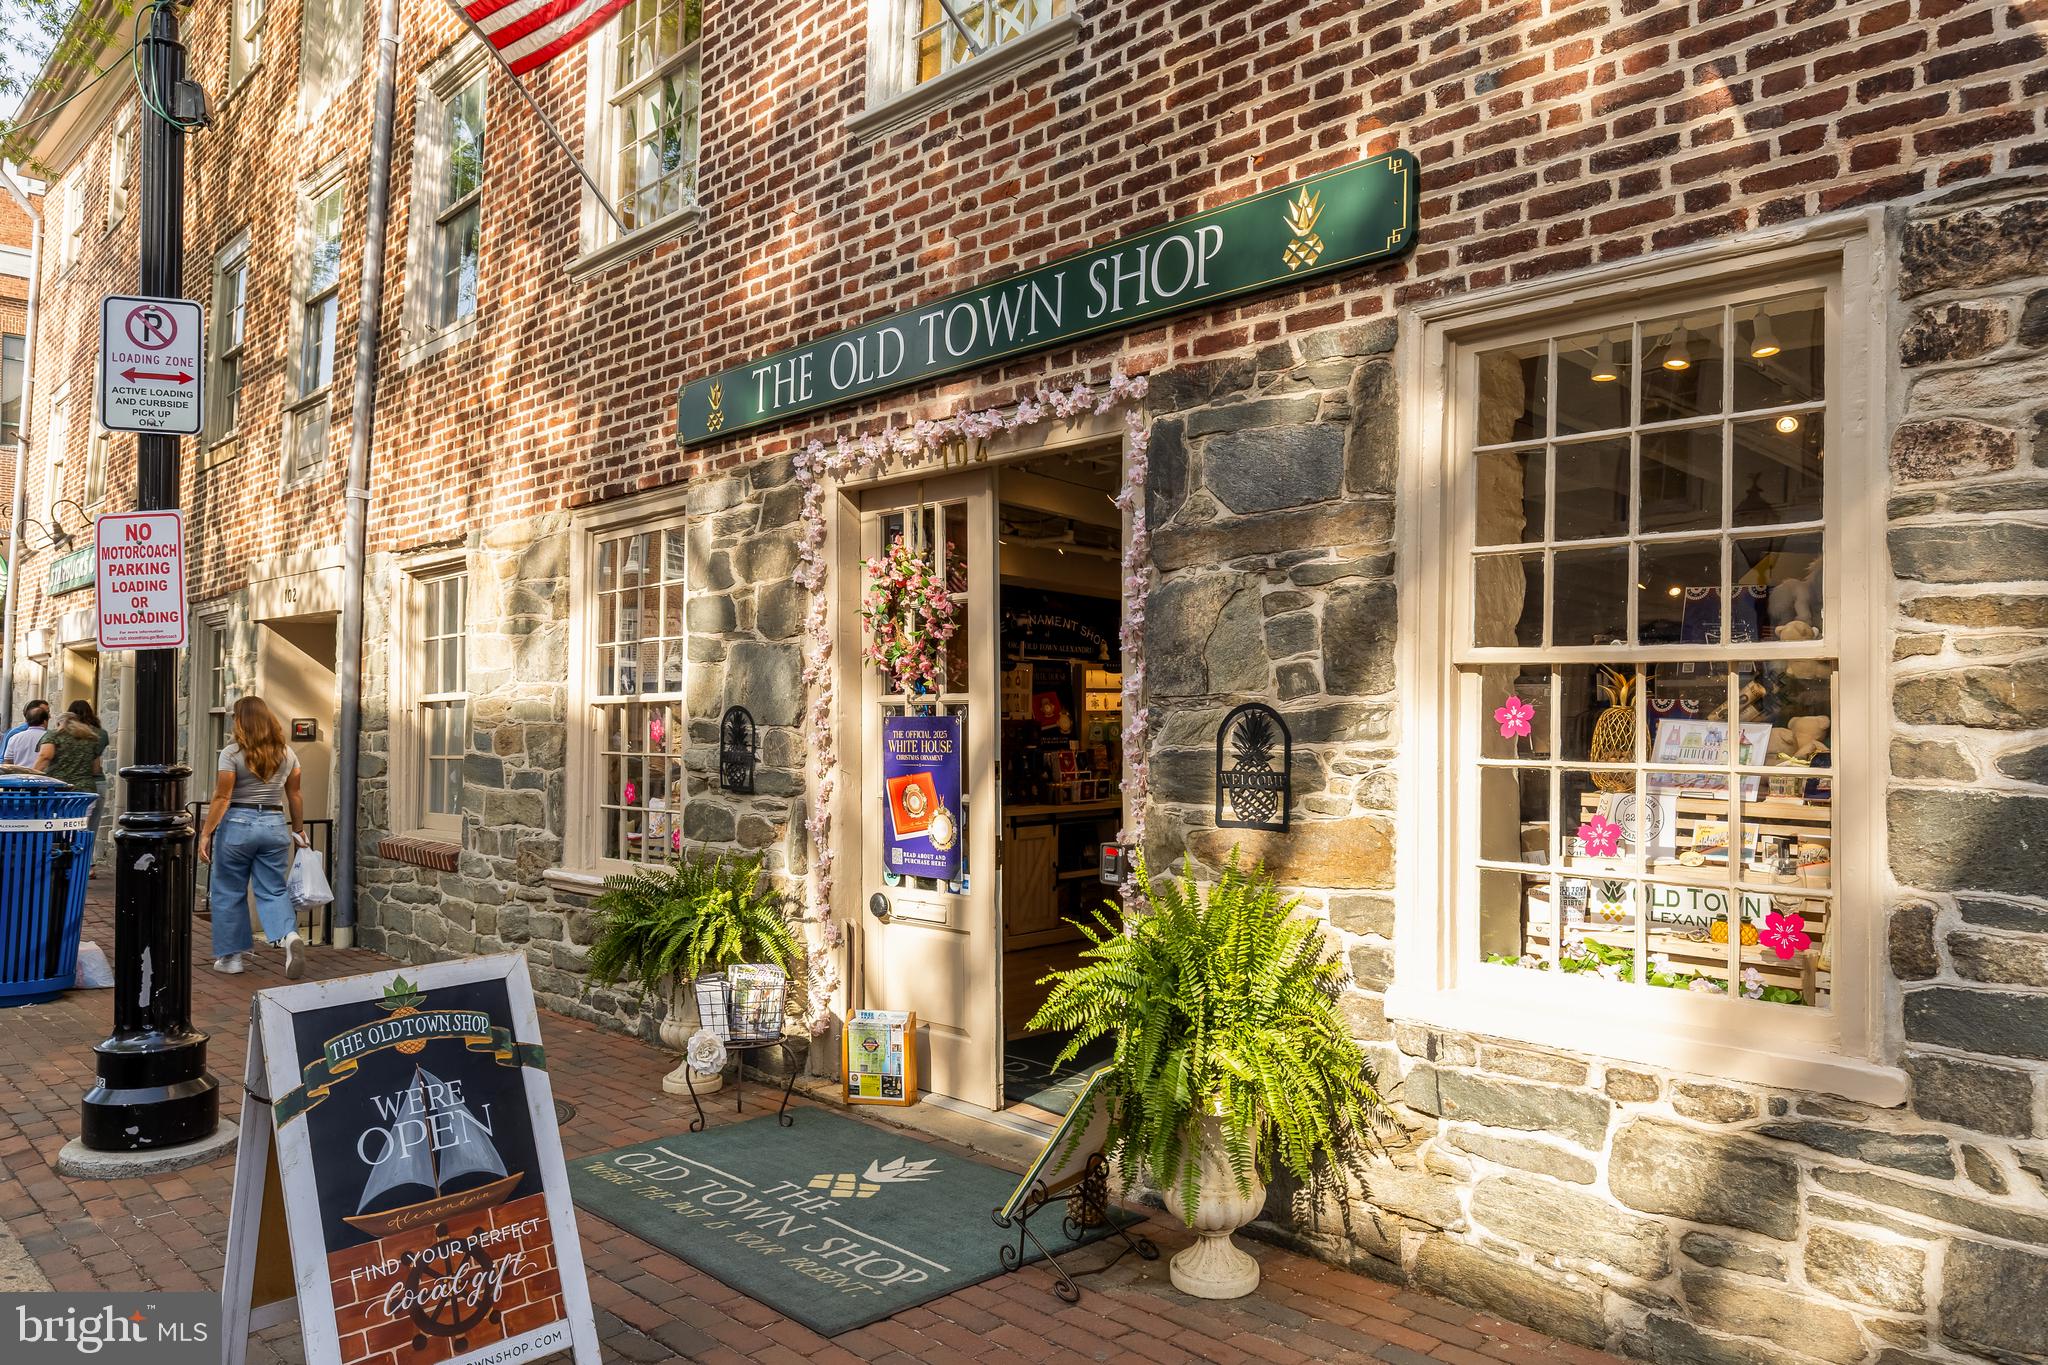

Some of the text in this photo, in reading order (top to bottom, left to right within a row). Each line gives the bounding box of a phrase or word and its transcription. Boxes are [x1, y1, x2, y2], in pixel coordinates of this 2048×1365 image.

[752, 224, 1224, 414] THE OLD TOWN SHOP
[112, 352, 194, 368] LOADING ZONE
[112, 386, 194, 398] ACTIVE LOADING
[115, 398, 189, 408] AND CURBSIDE
[132, 409, 171, 418] PICK UP
[125, 523, 152, 541] NO
[101, 544, 177, 560] MOTORCOACH
[109, 562, 170, 576] PARKING
[112, 580, 168, 593] LOADING
[131, 597, 148, 608] OR
[285, 588, 296, 603] 102
[104, 611, 179, 625] UNLOADING
[1029, 614, 1104, 645] NAMENT SHO
[1059, 644, 1093, 653] ALEXANDRI
[892, 730, 948, 739] THE OFFICIAL 2025
[888, 739, 953, 753] WHITE HOUSE
[1220, 773, 1287, 787] WELCOME
[1625, 813, 1651, 822] 224
[904, 858, 930, 866] PURCHASE
[330, 1014, 489, 1061] THE OLD TOWN SHOP
[357, 1104, 493, 1165] OPEN
[761, 1180, 840, 1215] THE
[614, 1153, 929, 1286] OLD TOWN SHOP
[631, 1185, 676, 1200] THE
[702, 1220, 736, 1229] IS
[727, 1231, 786, 1255] YOUR
[351, 1218, 540, 1282] FIND YOUR PERFECT
[466, 1251, 538, 1307] gift
[467, 1331, 562, 1365] WNSHOP.COM
